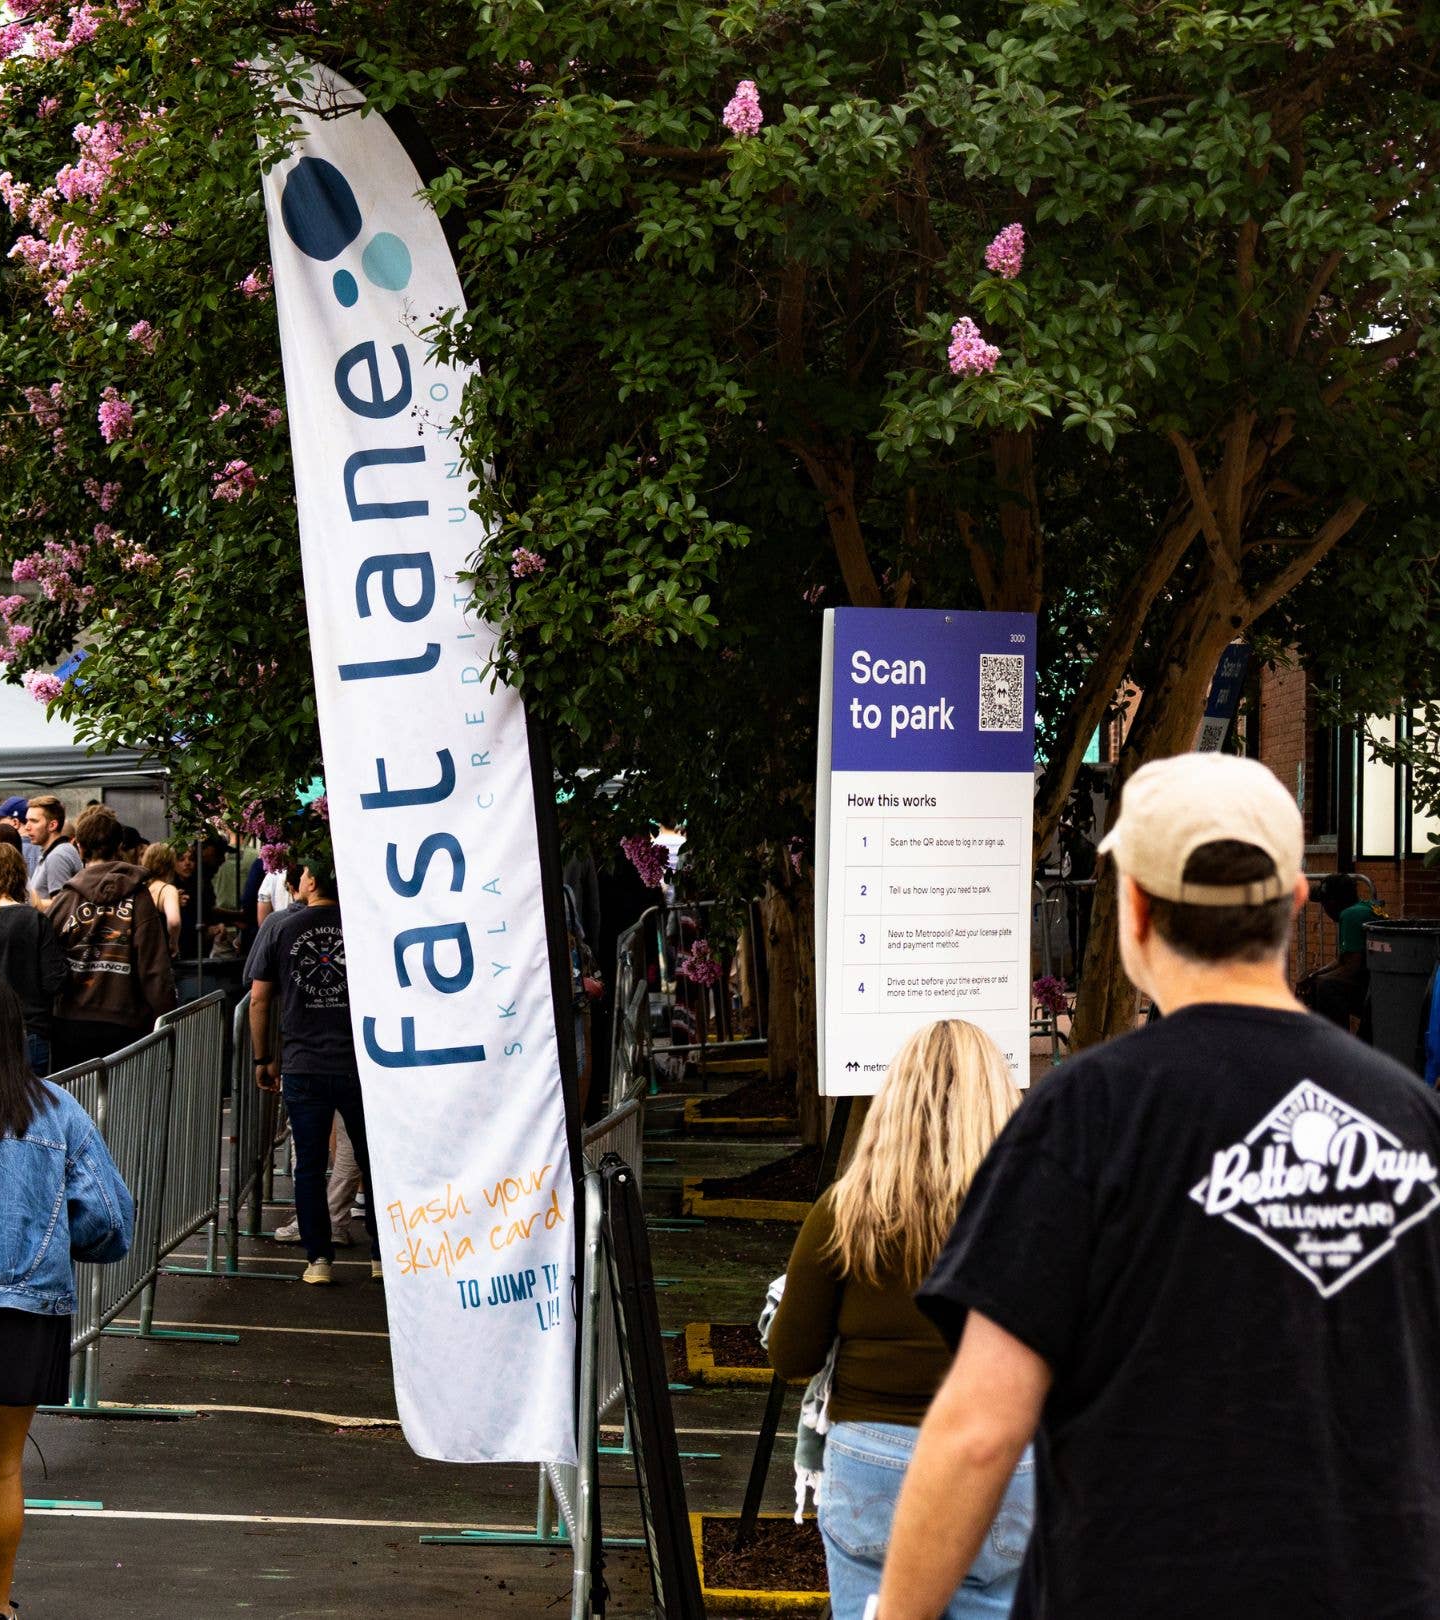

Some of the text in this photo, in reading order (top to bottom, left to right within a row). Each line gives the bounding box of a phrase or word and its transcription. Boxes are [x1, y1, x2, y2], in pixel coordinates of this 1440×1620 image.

[1009, 634, 1026, 643] 3000
[850, 650, 927, 685] Scan
[334, 340, 486, 1069] fast lane
[426, 342, 523, 1057] SKYLA CREDIT UNIO
[850, 697, 955, 739] to park
[847, 793, 937, 808] How this works
[862, 836, 867, 847] 1
[890, 838, 908, 847] Scan
[910, 838, 921, 847] the
[923, 838, 935, 848] QR
[935, 838, 954, 847] above
[955, 838, 961, 847] to
[860, 885, 867, 896] 2
[889, 885, 901, 895] Tell
[902, 887, 912, 895] us
[913, 885, 928, 895] how
[930, 885, 945, 896] long
[946, 887, 957, 896] you
[958, 886, 971, 894] need
[290, 929, 314, 957] ROCKY
[859, 934, 866, 944] 3
[888, 930, 905, 938] New
[906, 930, 913, 938] to
[915, 929, 954, 939] Metropolis?
[967, 930, 979, 939] your
[887, 940, 901, 949] and
[903, 940, 934, 950] payment
[290, 970, 317, 996] CIGAR
[858, 982, 866, 994] 4
[887, 978, 905, 986] Drive
[907, 978, 919, 986] out
[921, 977, 944, 986] before
[945, 978, 958, 987] your
[958, 977, 971, 985] time
[998, 975, 1009, 984] add
[887, 989, 906, 997] more
[907, 989, 922, 997] time
[924, 989, 932, 997] to
[933, 988, 956, 997] extend
[956, 989, 968, 998] your
[1204, 1123, 1438, 1215] Better Days
[387, 1165, 552, 1235] Flash your
[490, 1189, 566, 1250] card
[456, 1278, 480, 1310] TO
[487, 1269, 537, 1306] JUMP
